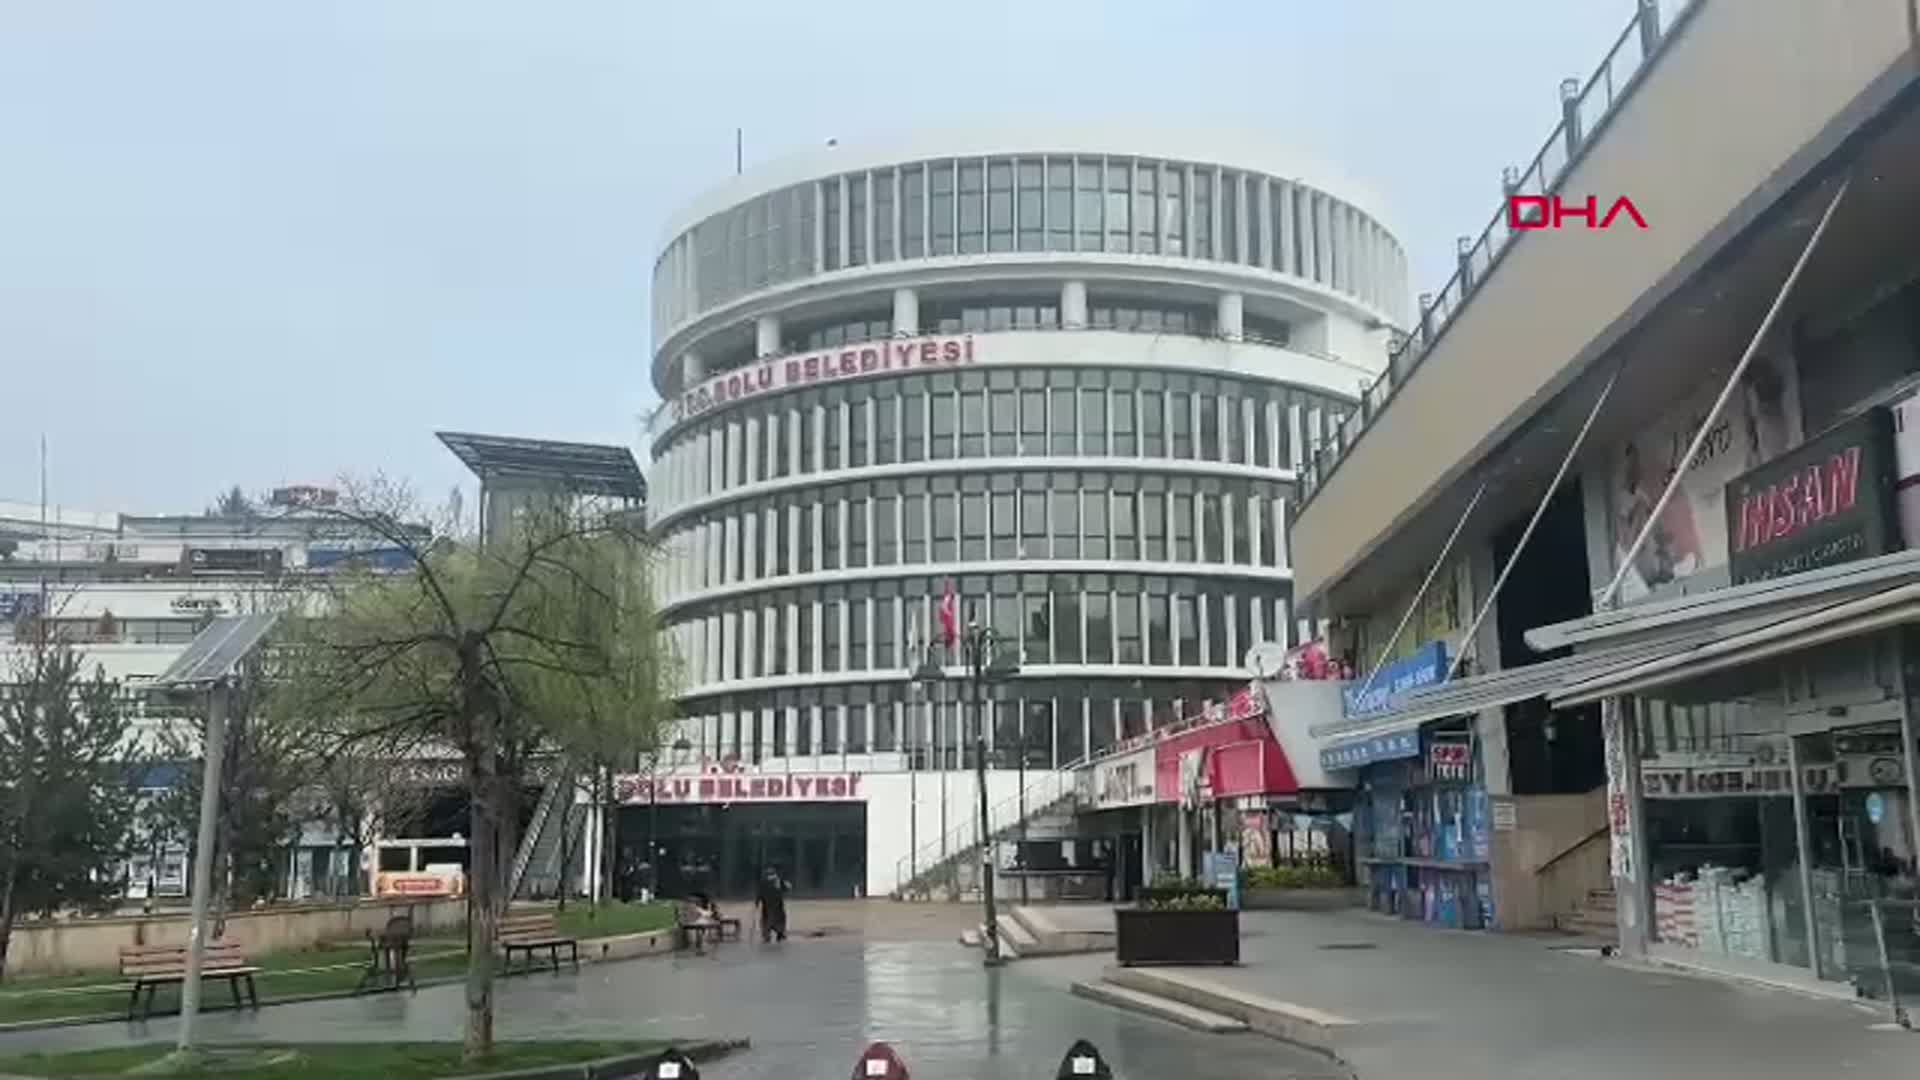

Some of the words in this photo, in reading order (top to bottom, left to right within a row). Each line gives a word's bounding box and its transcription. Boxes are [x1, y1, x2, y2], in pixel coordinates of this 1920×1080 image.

[714, 366, 772, 401] BOLU
[785, 335, 974, 383] BELEDİYESİ
[699, 773, 858, 798] BELEDİYESİ
